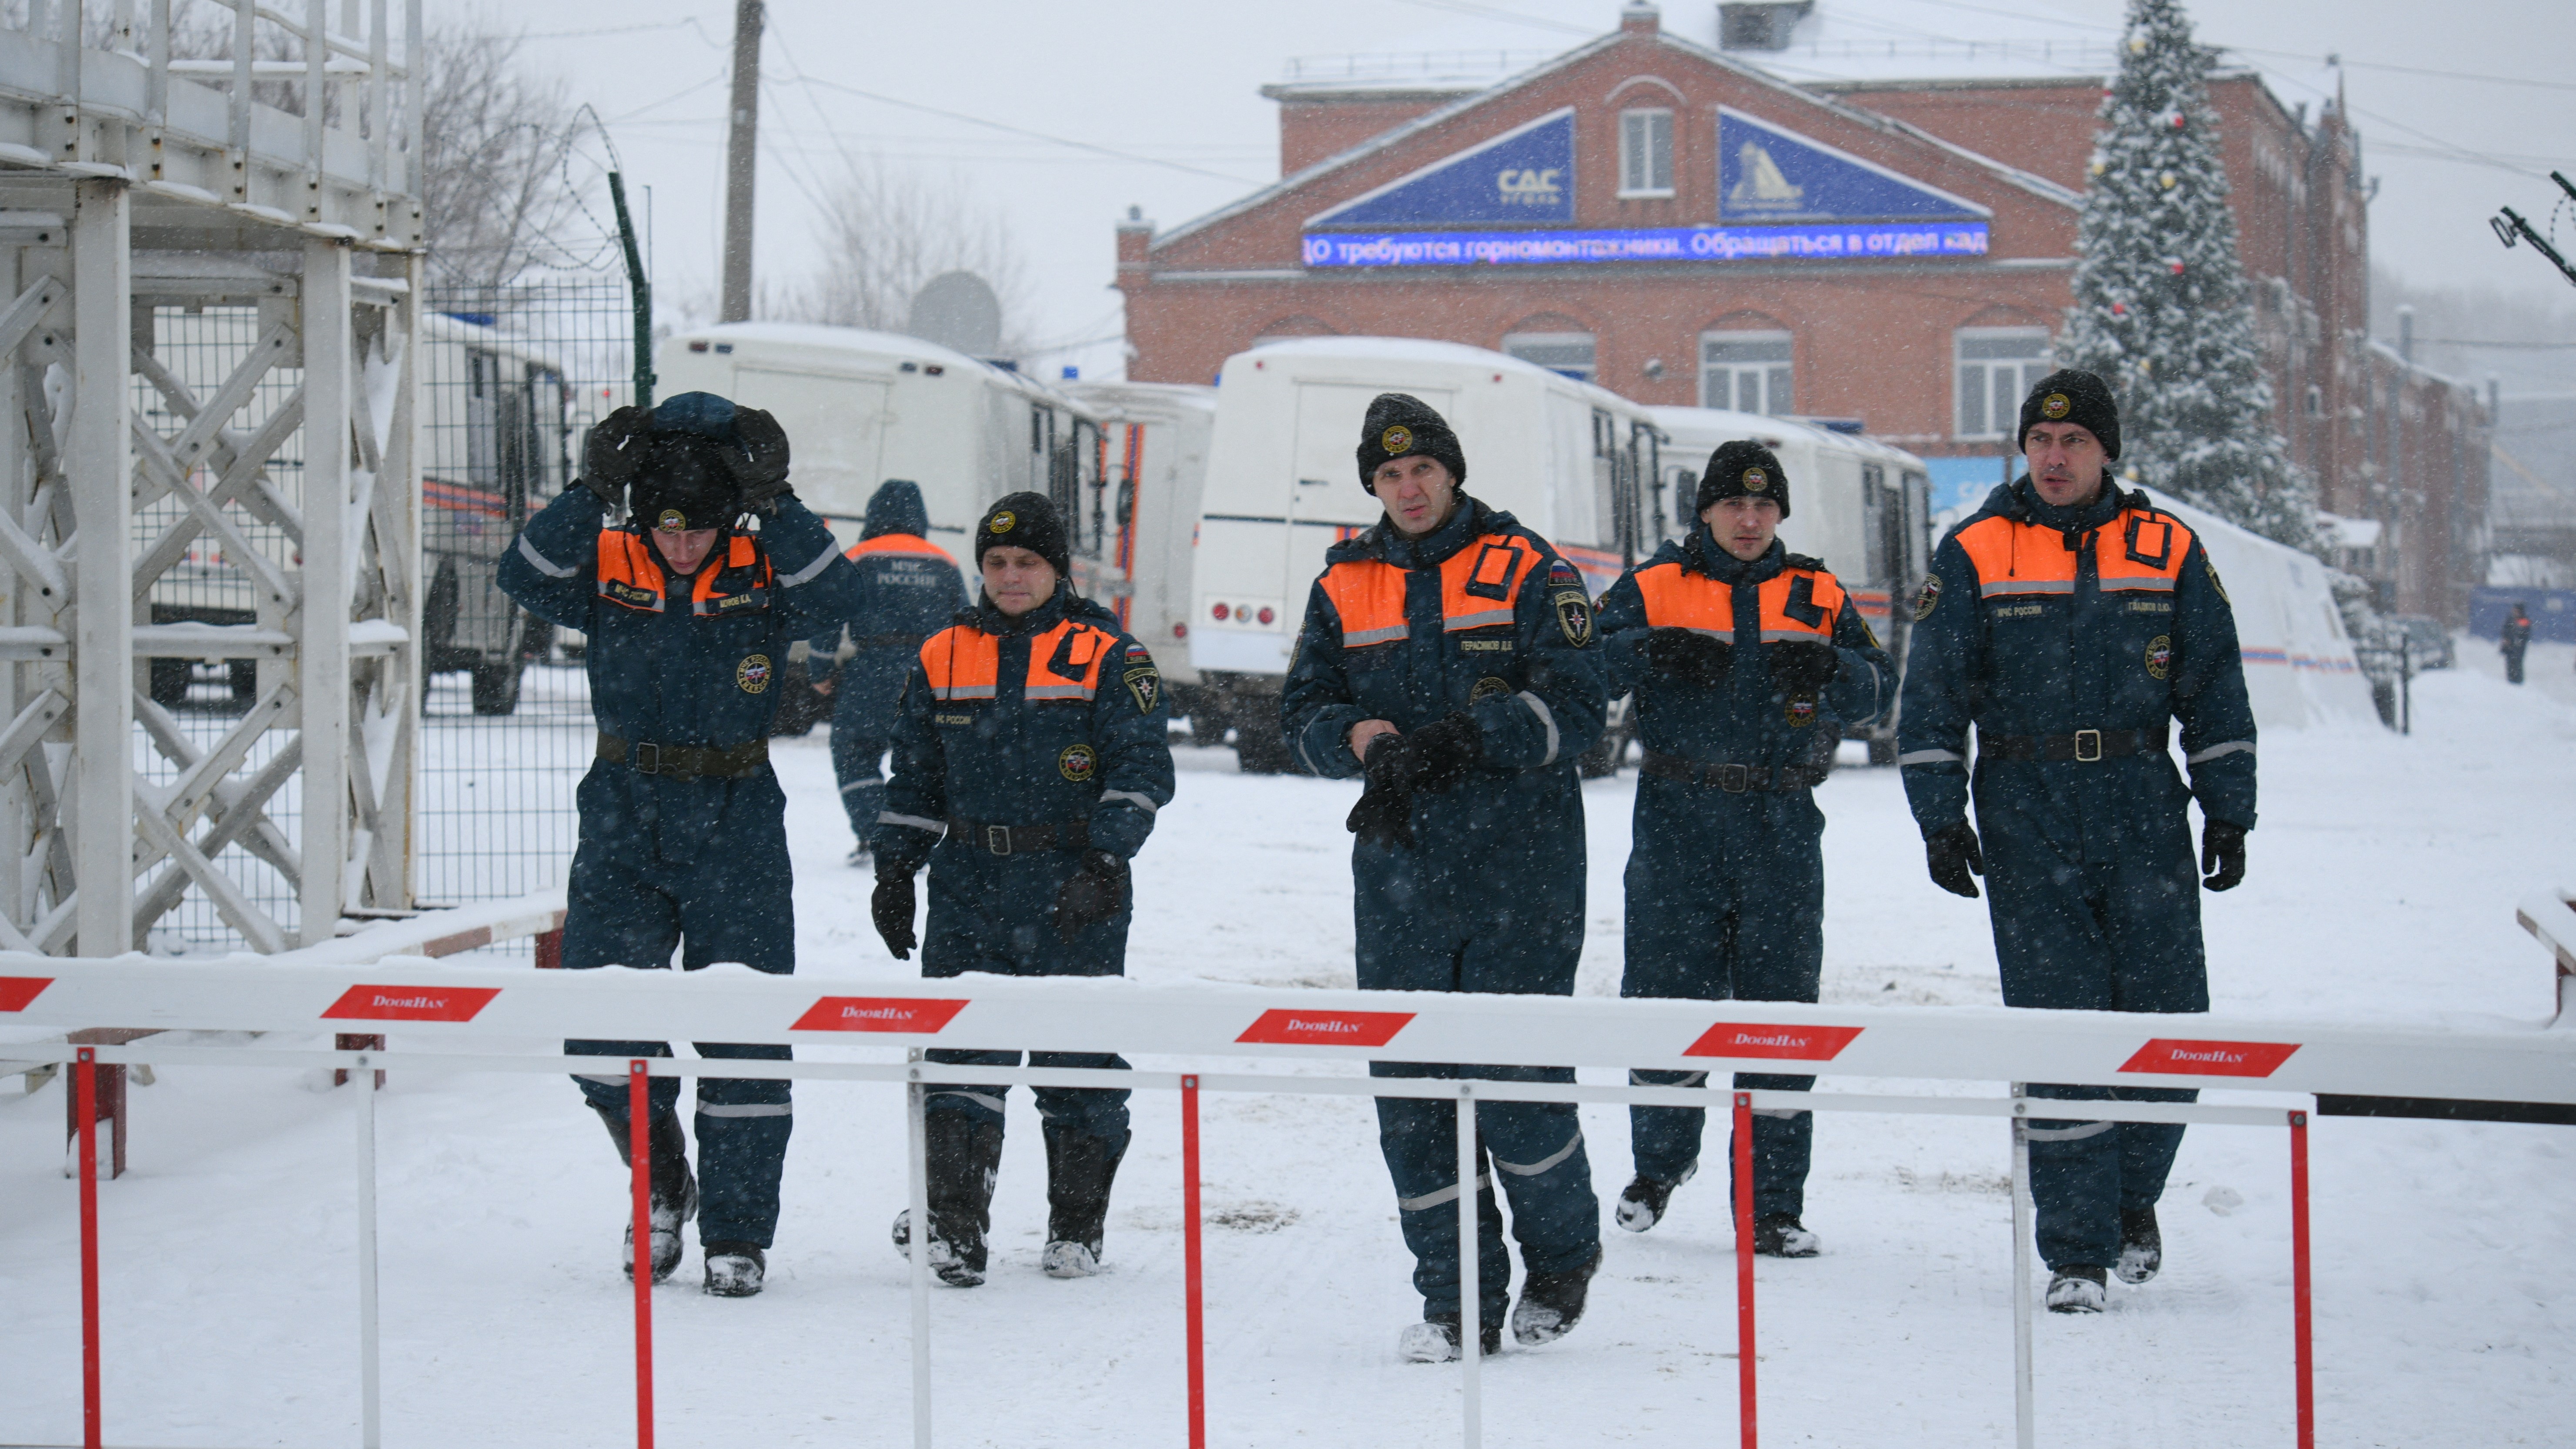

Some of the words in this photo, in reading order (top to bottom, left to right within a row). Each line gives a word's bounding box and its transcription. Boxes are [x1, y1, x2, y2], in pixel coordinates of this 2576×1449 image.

[1337, 236, 1461, 265] требуются
[1691, 231, 1842, 259] Обращаться
[1847, 234, 1863, 253] в
[1866, 233, 1939, 255] отдел
[892, 561, 922, 572] МЧС
[877, 572, 936, 586] РОССИИ
[1997, 608, 2013, 618] МЧС
[2014, 605, 2042, 616] РОССИИ
[946, 715, 971, 725] РОССИИ
